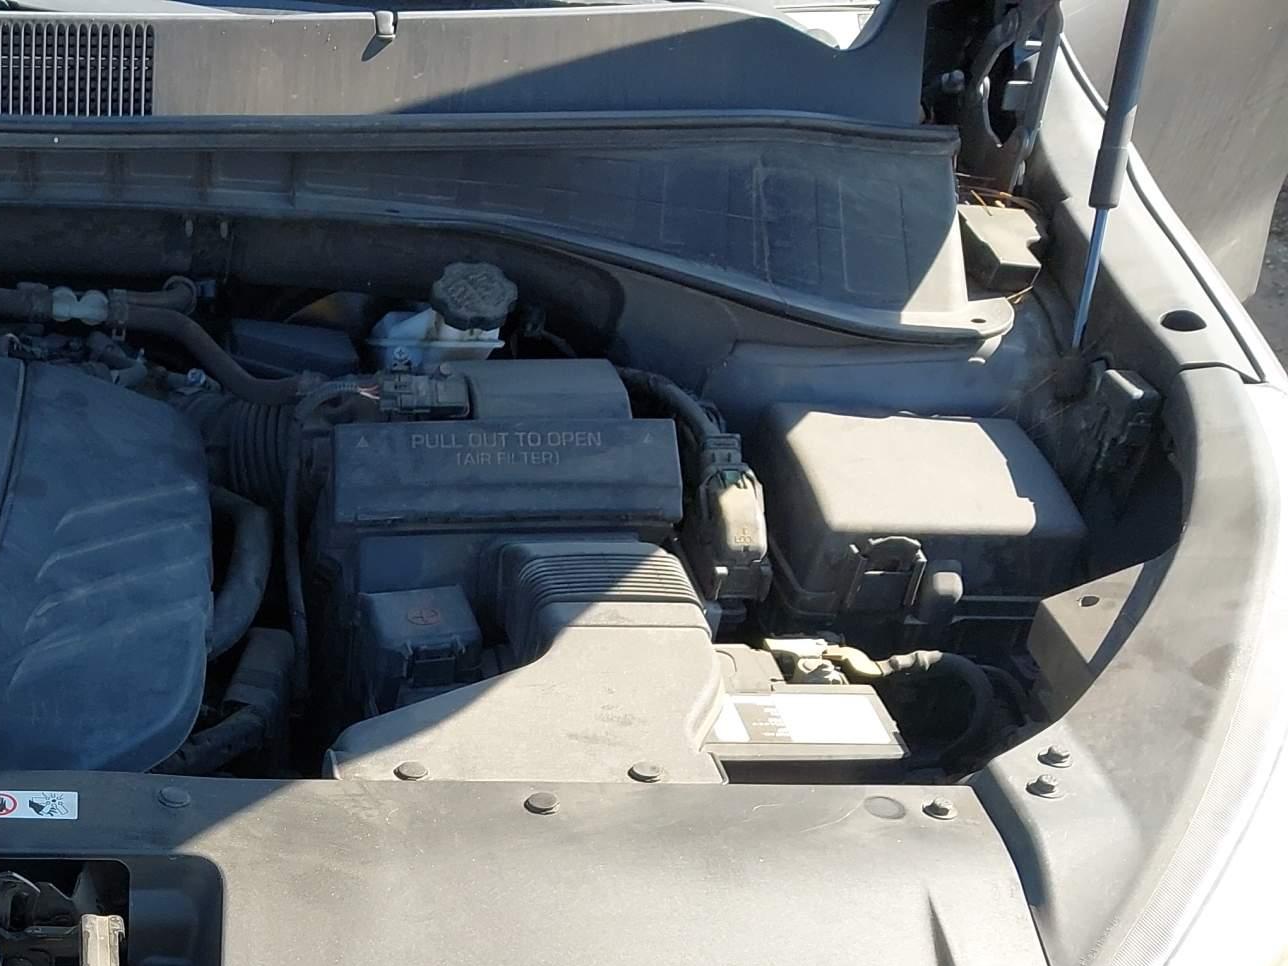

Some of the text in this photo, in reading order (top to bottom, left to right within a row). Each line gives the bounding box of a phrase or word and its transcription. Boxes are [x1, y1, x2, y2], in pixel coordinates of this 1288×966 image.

[411, 430, 602, 449] PULL OUT TO OPEN
